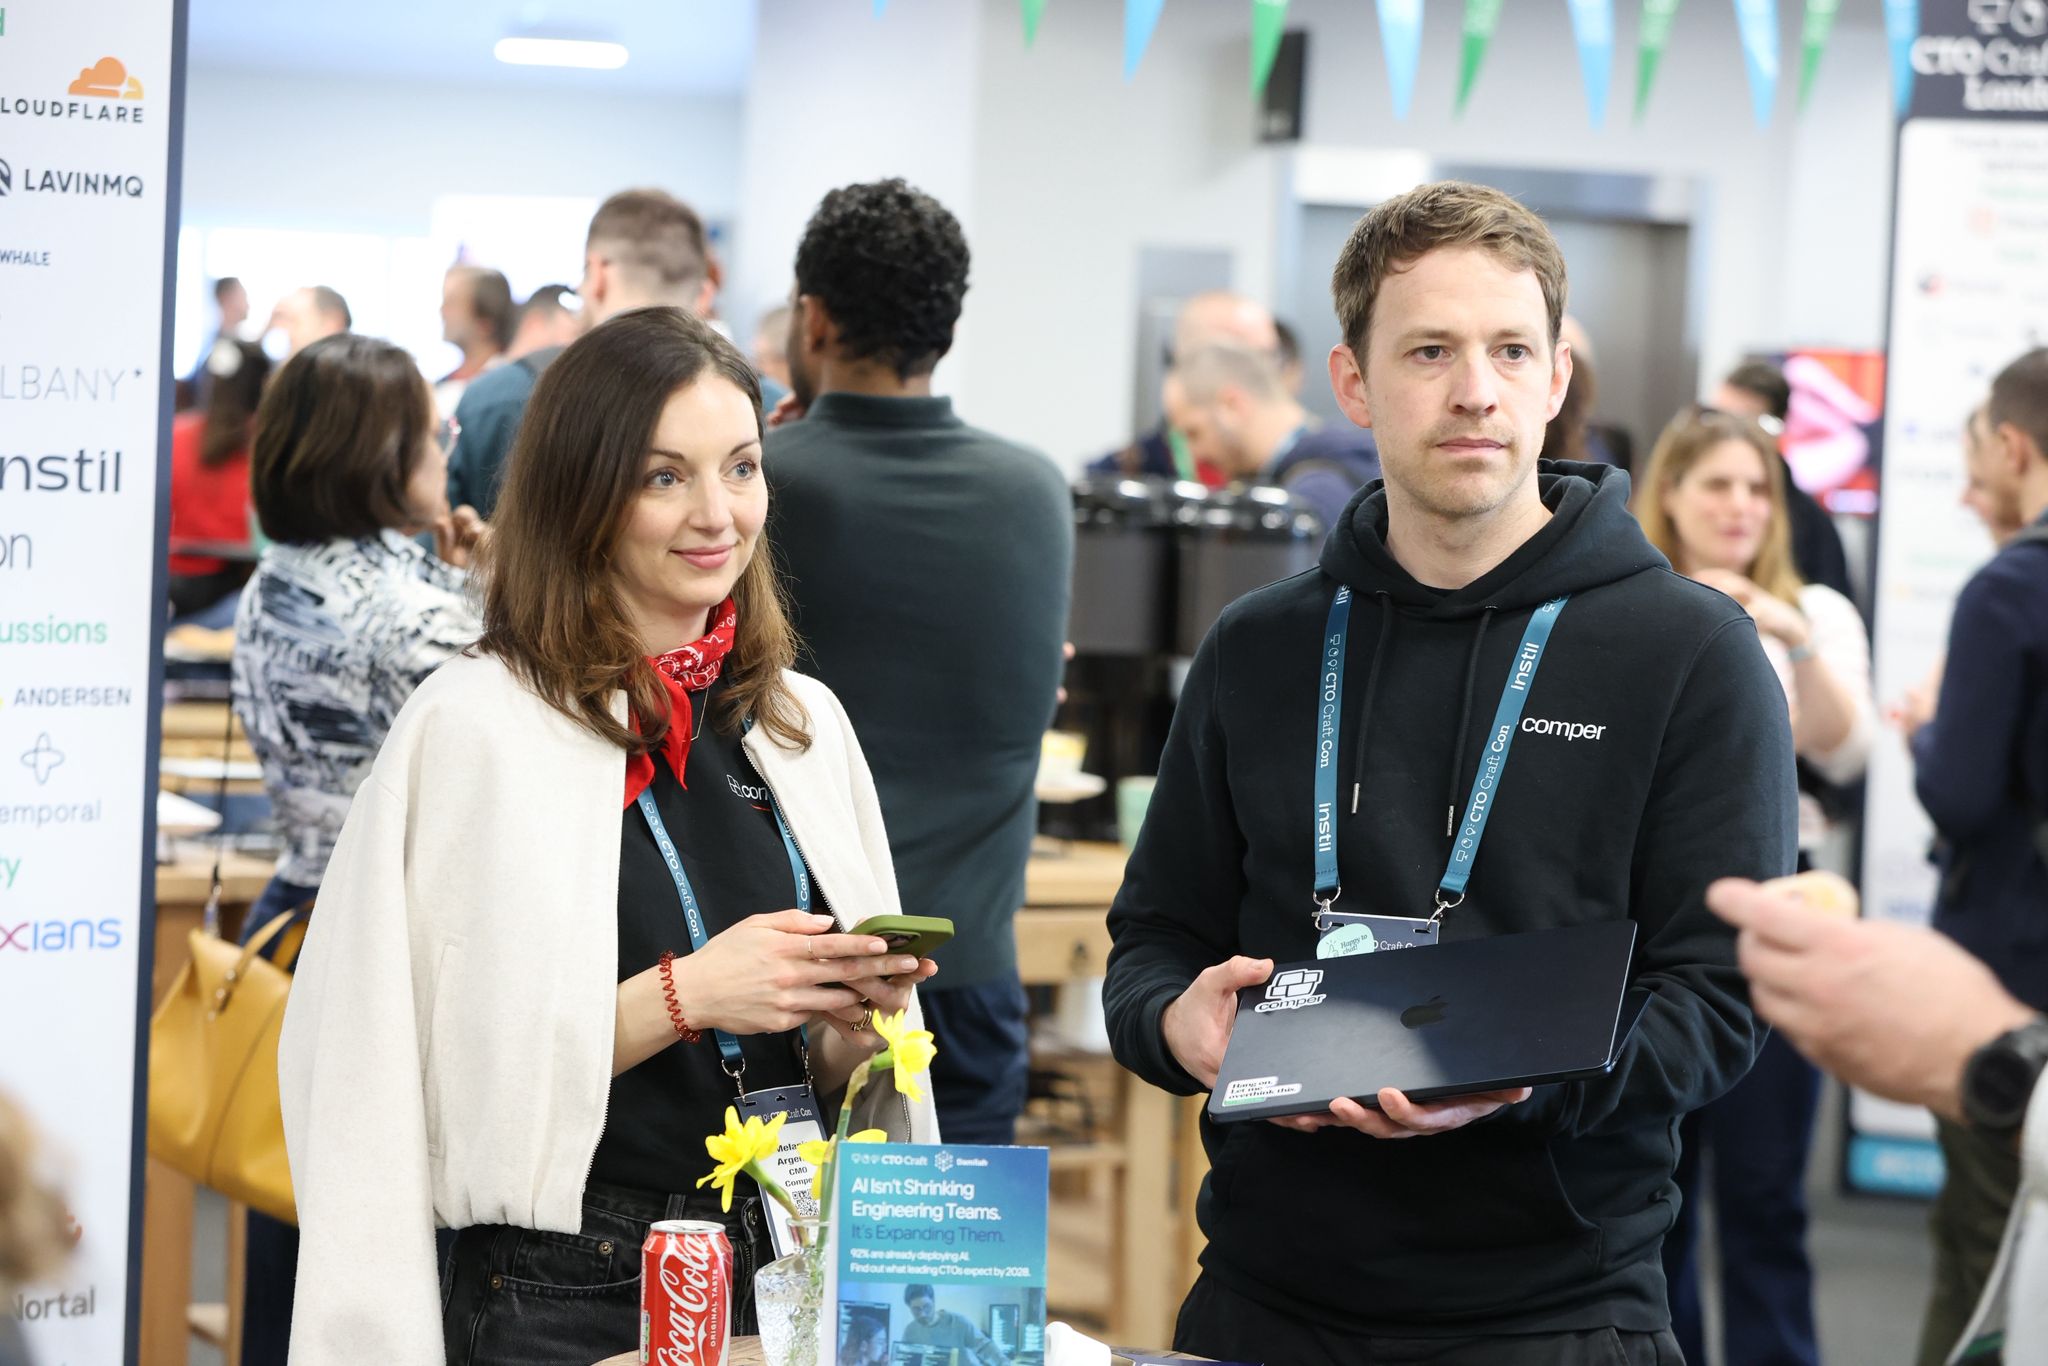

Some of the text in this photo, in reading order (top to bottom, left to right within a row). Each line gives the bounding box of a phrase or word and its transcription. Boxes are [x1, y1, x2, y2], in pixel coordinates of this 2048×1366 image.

[25, 168, 143, 198] LAVINMQ
[14, 687, 132, 706] ANDERSEN
[1320, 672, 1338, 769] CTO Craft Con
[1521, 717, 1606, 741] comper
[1469, 724, 1510, 823] CTO Craft Con
[661, 840, 700, 938] CTO Craft Con
[1259, 996, 1325, 1011] comper
[784, 1177, 813, 1188] Compe
[788, 1166, 808, 1176] CMO
[851, 1177, 975, 1201] AI Isn't Shrinking
[852, 1200, 1002, 1222] Engineering Teams.
[876, 1224, 955, 1245] Expanding
[958, 1226, 1005, 1243] Them.
[710, 1269, 719, 1347] ORIGINAL TASTE
